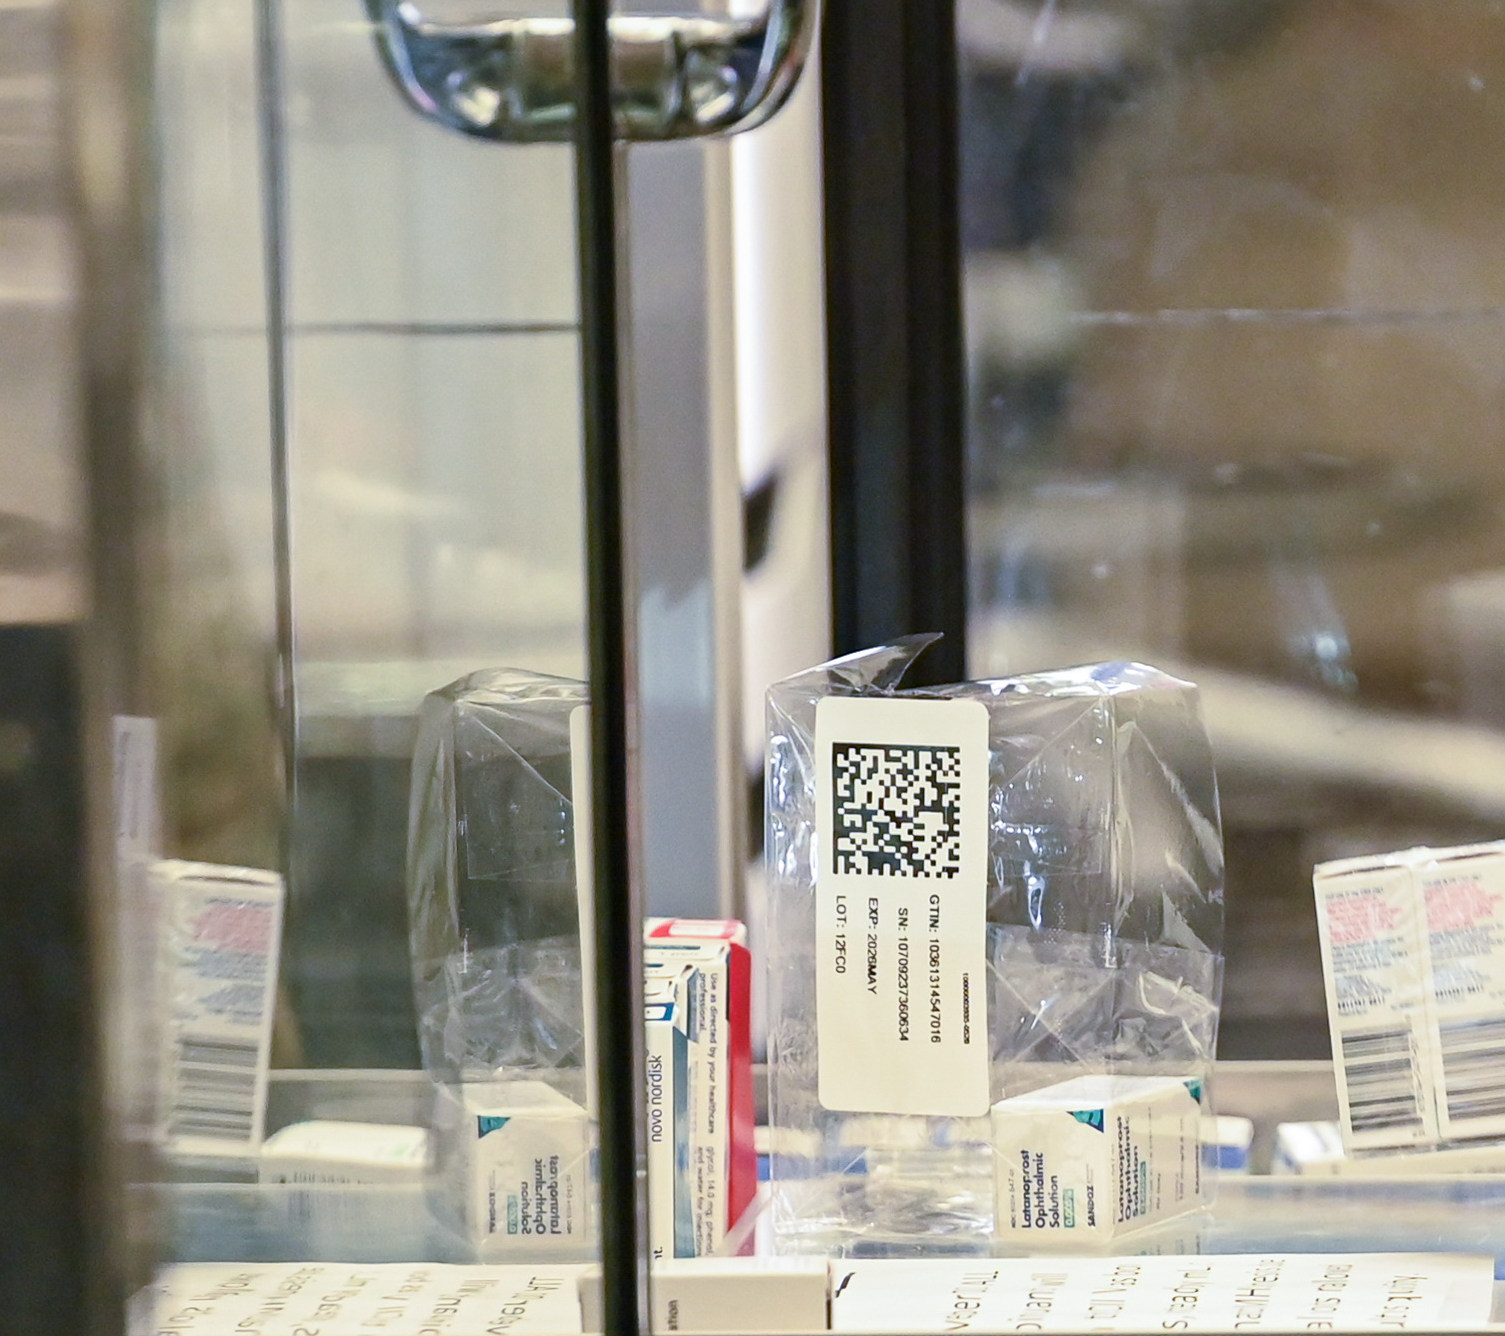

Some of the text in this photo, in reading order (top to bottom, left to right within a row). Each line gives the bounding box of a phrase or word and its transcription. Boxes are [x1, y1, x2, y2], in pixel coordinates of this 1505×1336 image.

[836, 895, 847, 929] LOT:
[868, 897, 879, 929] EXP:
[898, 907, 909, 931] SN:
[929, 894, 942, 1044] GTIN: 10361314547016
[709, 1006, 717, 1044] directed
[707, 1047, 717, 1059] by
[707, 1061, 715, 1083] your
[648, 1055, 663, 1143] novo nordisk
[708, 1085, 716, 1134] healthcare
[1021, 1149, 1032, 1229] Latanoprost
[1034, 1152, 1047, 1229] Ophthalmic
[1116, 1116, 1125, 1223] Latanoprost
[1125, 1117, 1134, 1220] Ophthalmic
[1049, 1175, 1060, 1228] Solution
